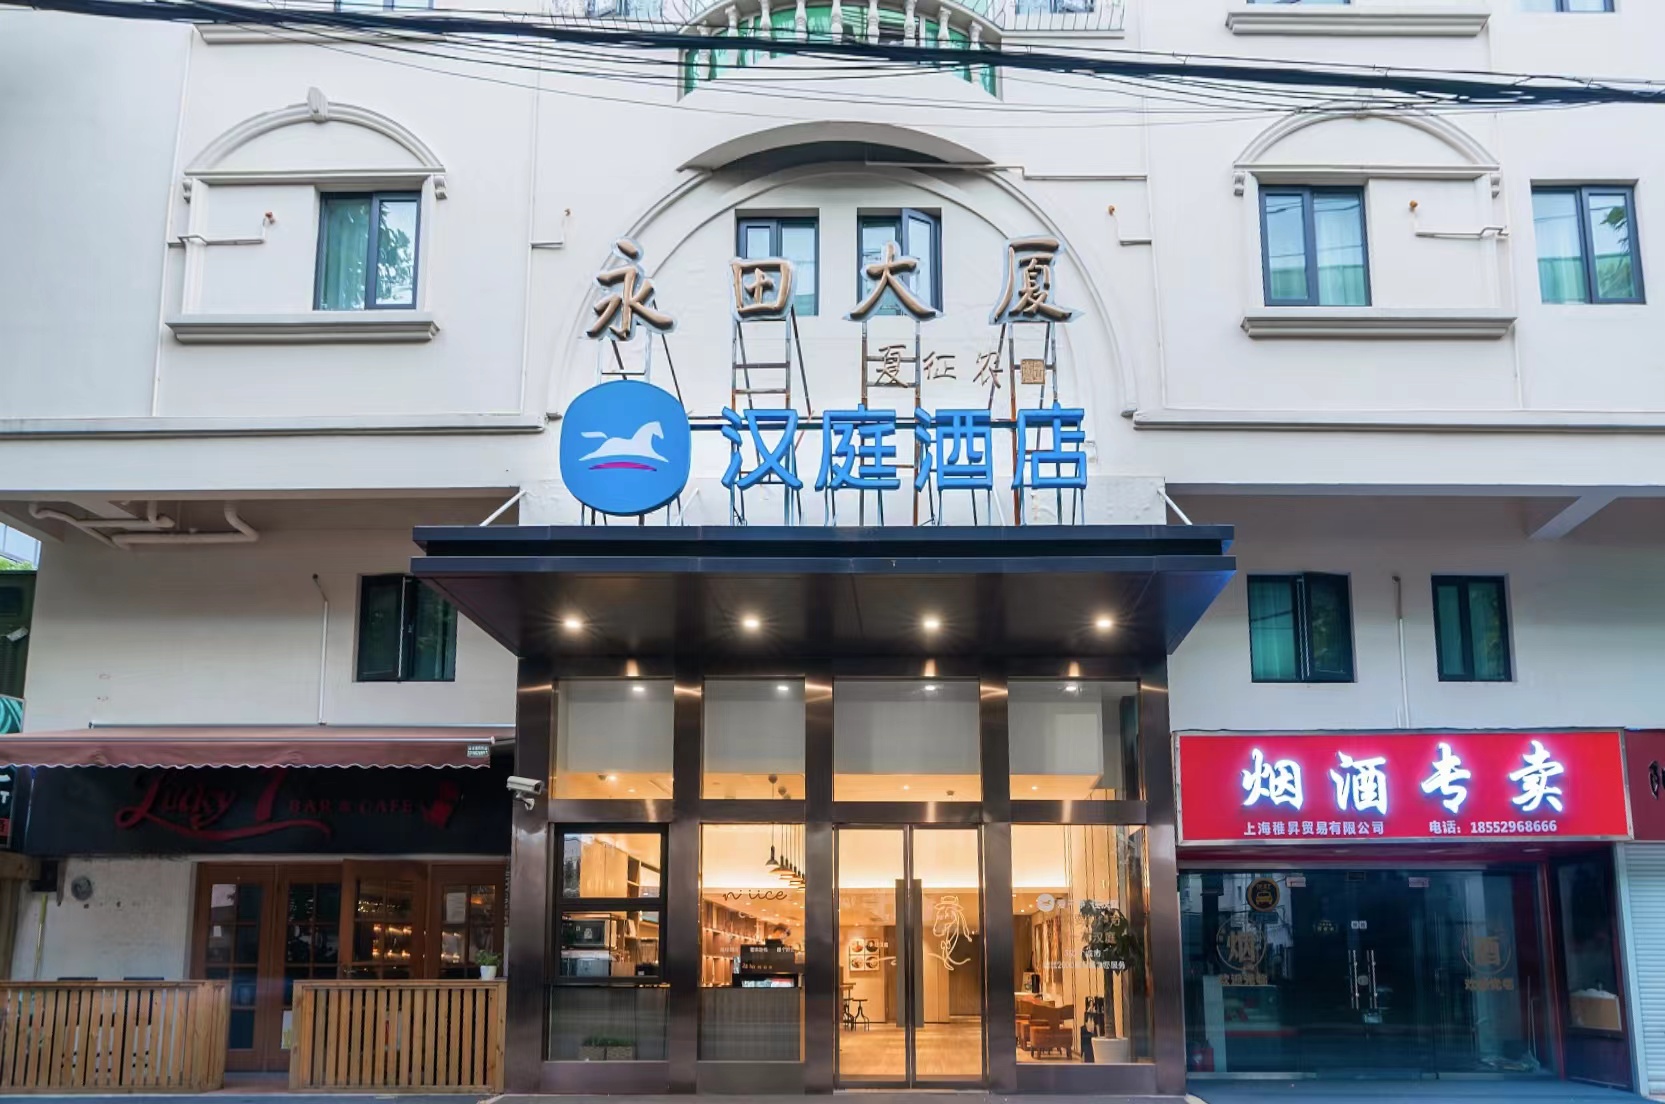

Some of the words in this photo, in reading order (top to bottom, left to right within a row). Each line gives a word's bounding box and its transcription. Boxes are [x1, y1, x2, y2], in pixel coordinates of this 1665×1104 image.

[586, 237, 1073, 341] 永田大厦
[721, 404, 1089, 491] 汉庭酒店
[289, 799, 332, 814] BAR
[359, 799, 414, 815] CAFE
[1241, 740, 1565, 815] 烟酒专卖
[1470, 820, 1558, 834] 18552968666
